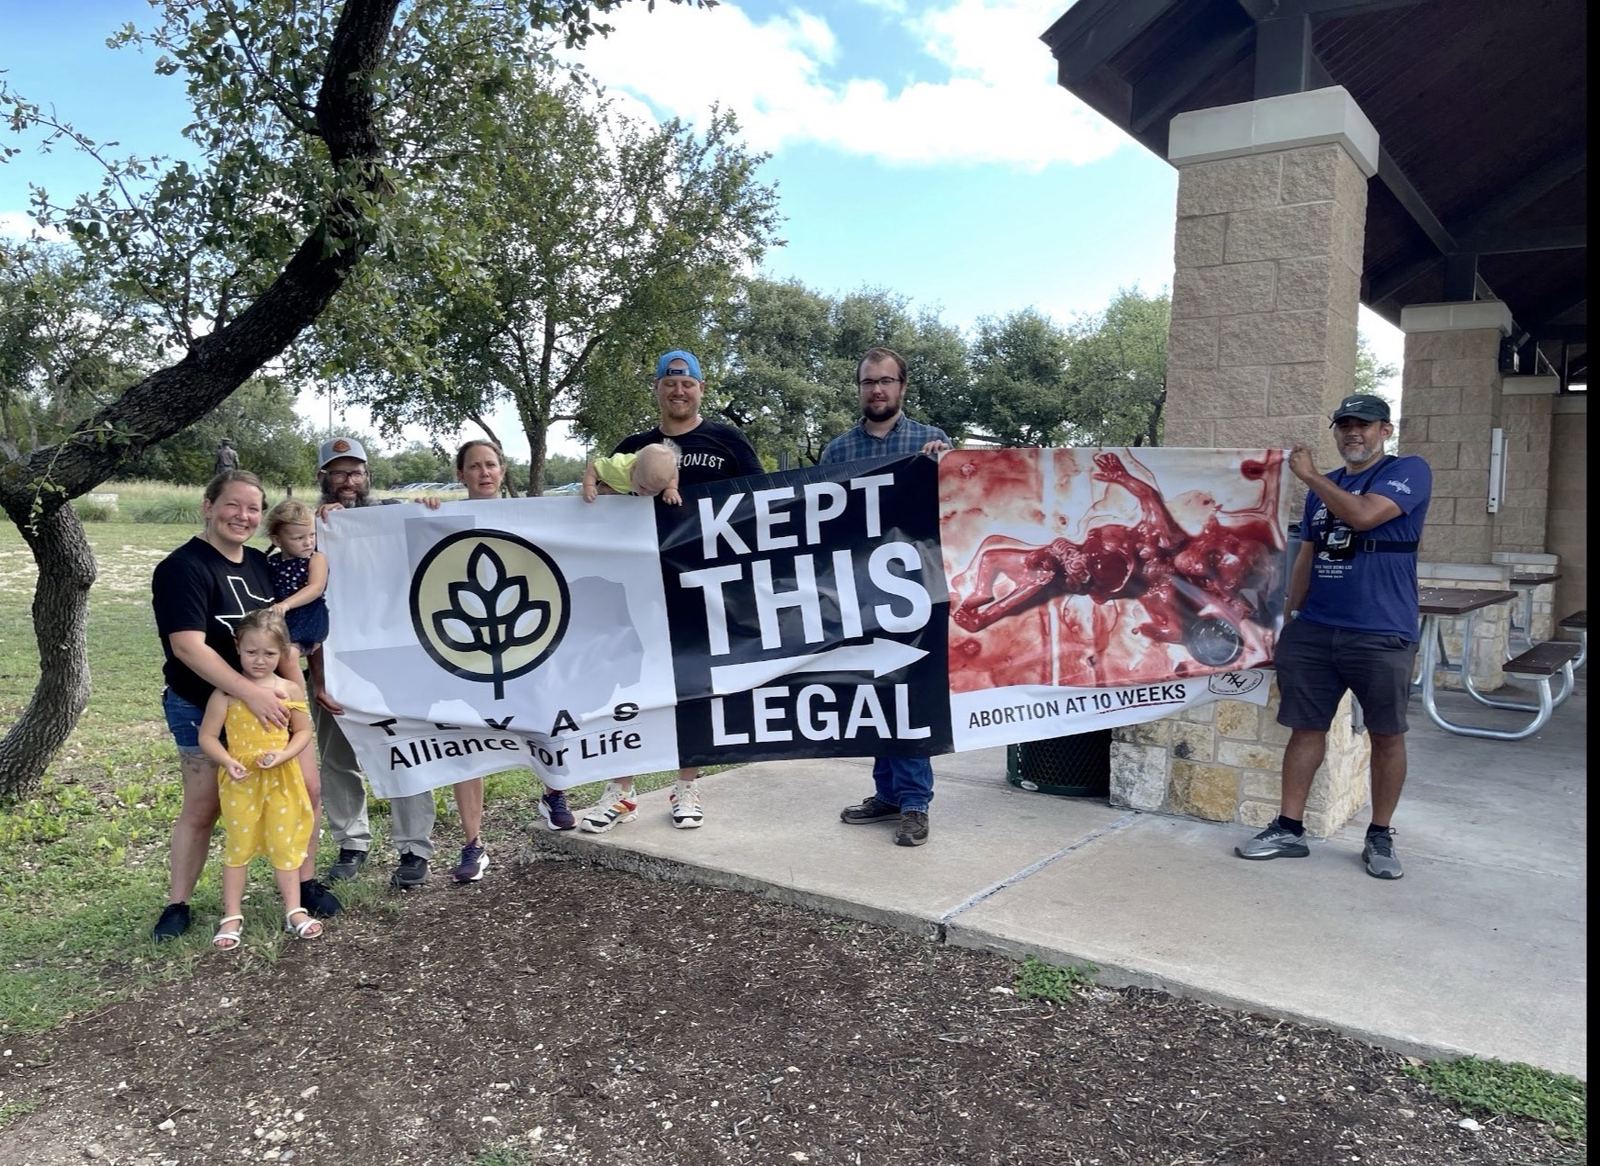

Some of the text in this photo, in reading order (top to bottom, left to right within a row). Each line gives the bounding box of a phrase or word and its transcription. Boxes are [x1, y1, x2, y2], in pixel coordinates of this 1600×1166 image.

[677, 453, 725, 470] IONIST
[697, 473, 895, 559] KEPT
[679, 541, 932, 656] THIS
[710, 683, 932, 747] LEGAL
[968, 701, 1060, 729] ABORTION
[1066, 696, 1088, 714] AT
[1091, 692, 1112, 711] 10
[1119, 683, 1187, 706] WEEKS
[390, 729, 642, 771] Alliance for Life
